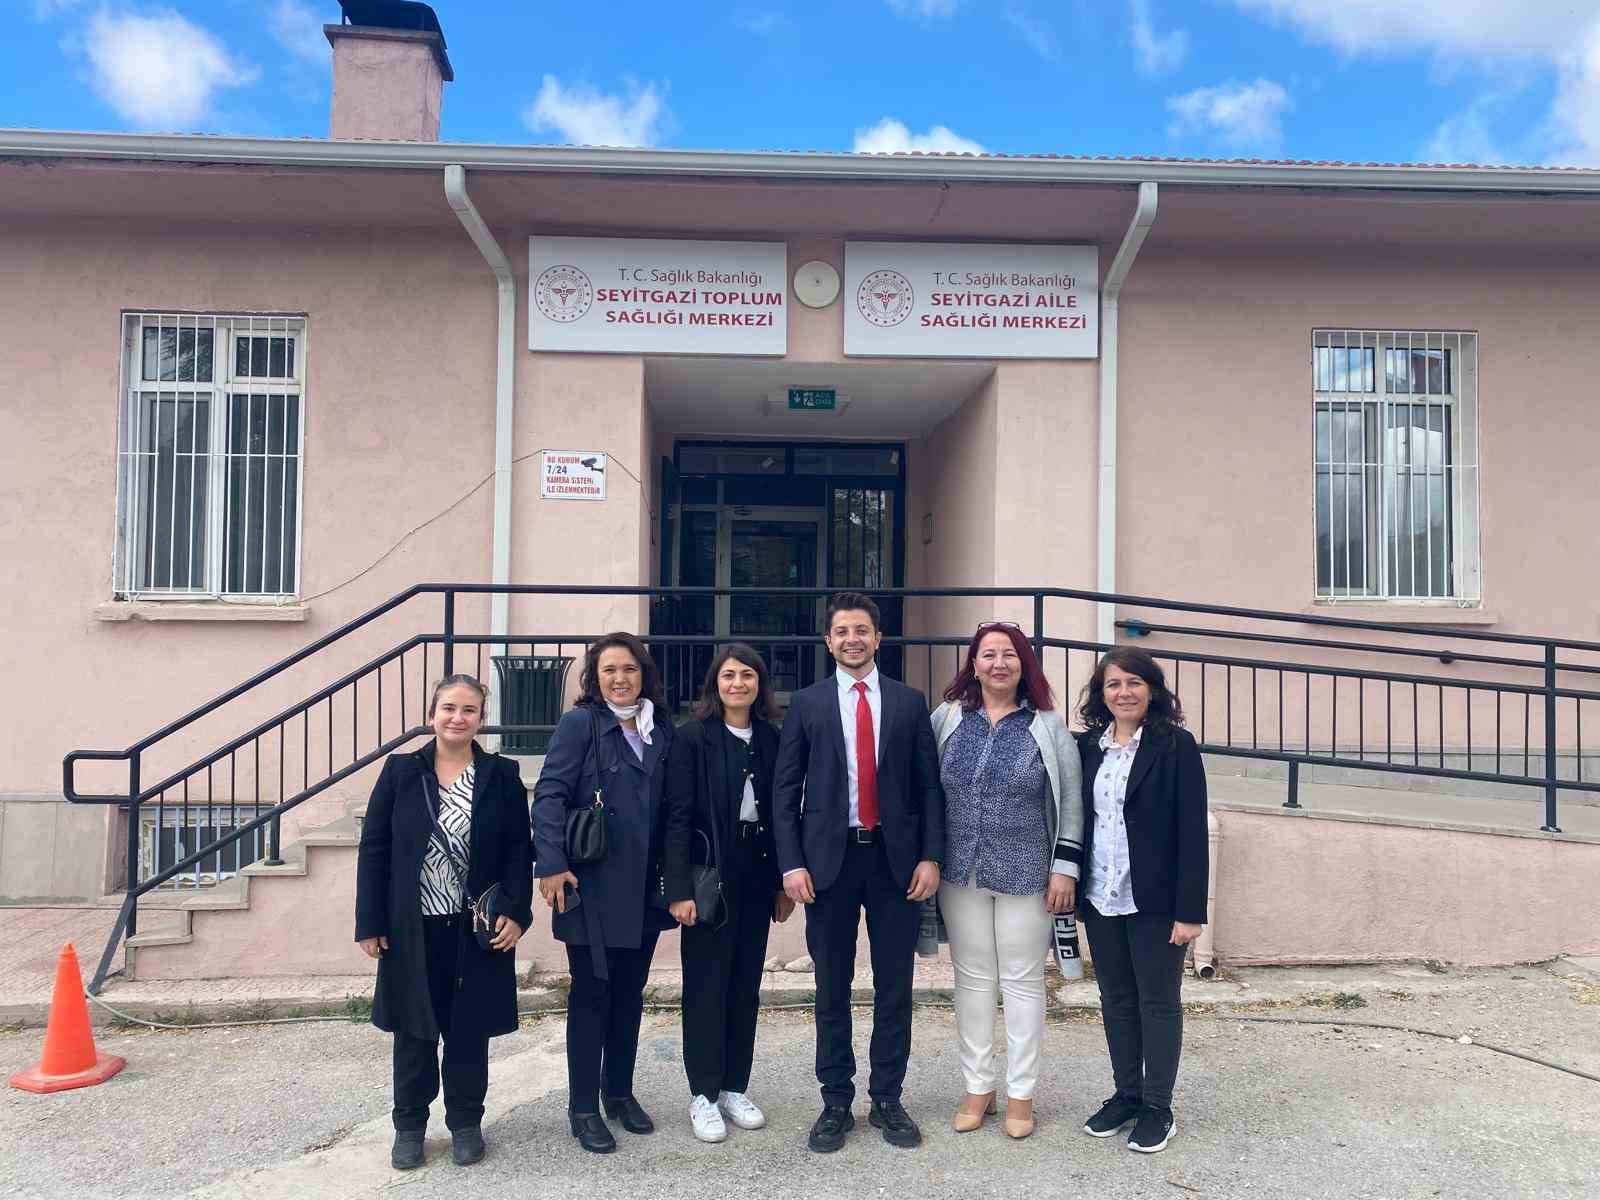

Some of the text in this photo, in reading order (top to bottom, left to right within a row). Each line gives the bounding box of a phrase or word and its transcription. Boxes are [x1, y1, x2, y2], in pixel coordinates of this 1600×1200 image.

[650, 268, 694, 286] Sağlık
[697, 270, 762, 288] Bakanlığı
[965, 272, 1008, 289] Sağlık
[1011, 273, 1076, 290] Bakanlığı
[596, 287, 782, 306] SEYİTGAZİ TOPLUM
[931, 291, 1077, 308] SEYİTGAZİ AİLE
[605, 308, 773, 327] SAĞLIĞI MERKEZİ
[920, 311, 1087, 329] SAĞLIĞI MERKEZİ
[547, 465, 567, 474] 7/24
